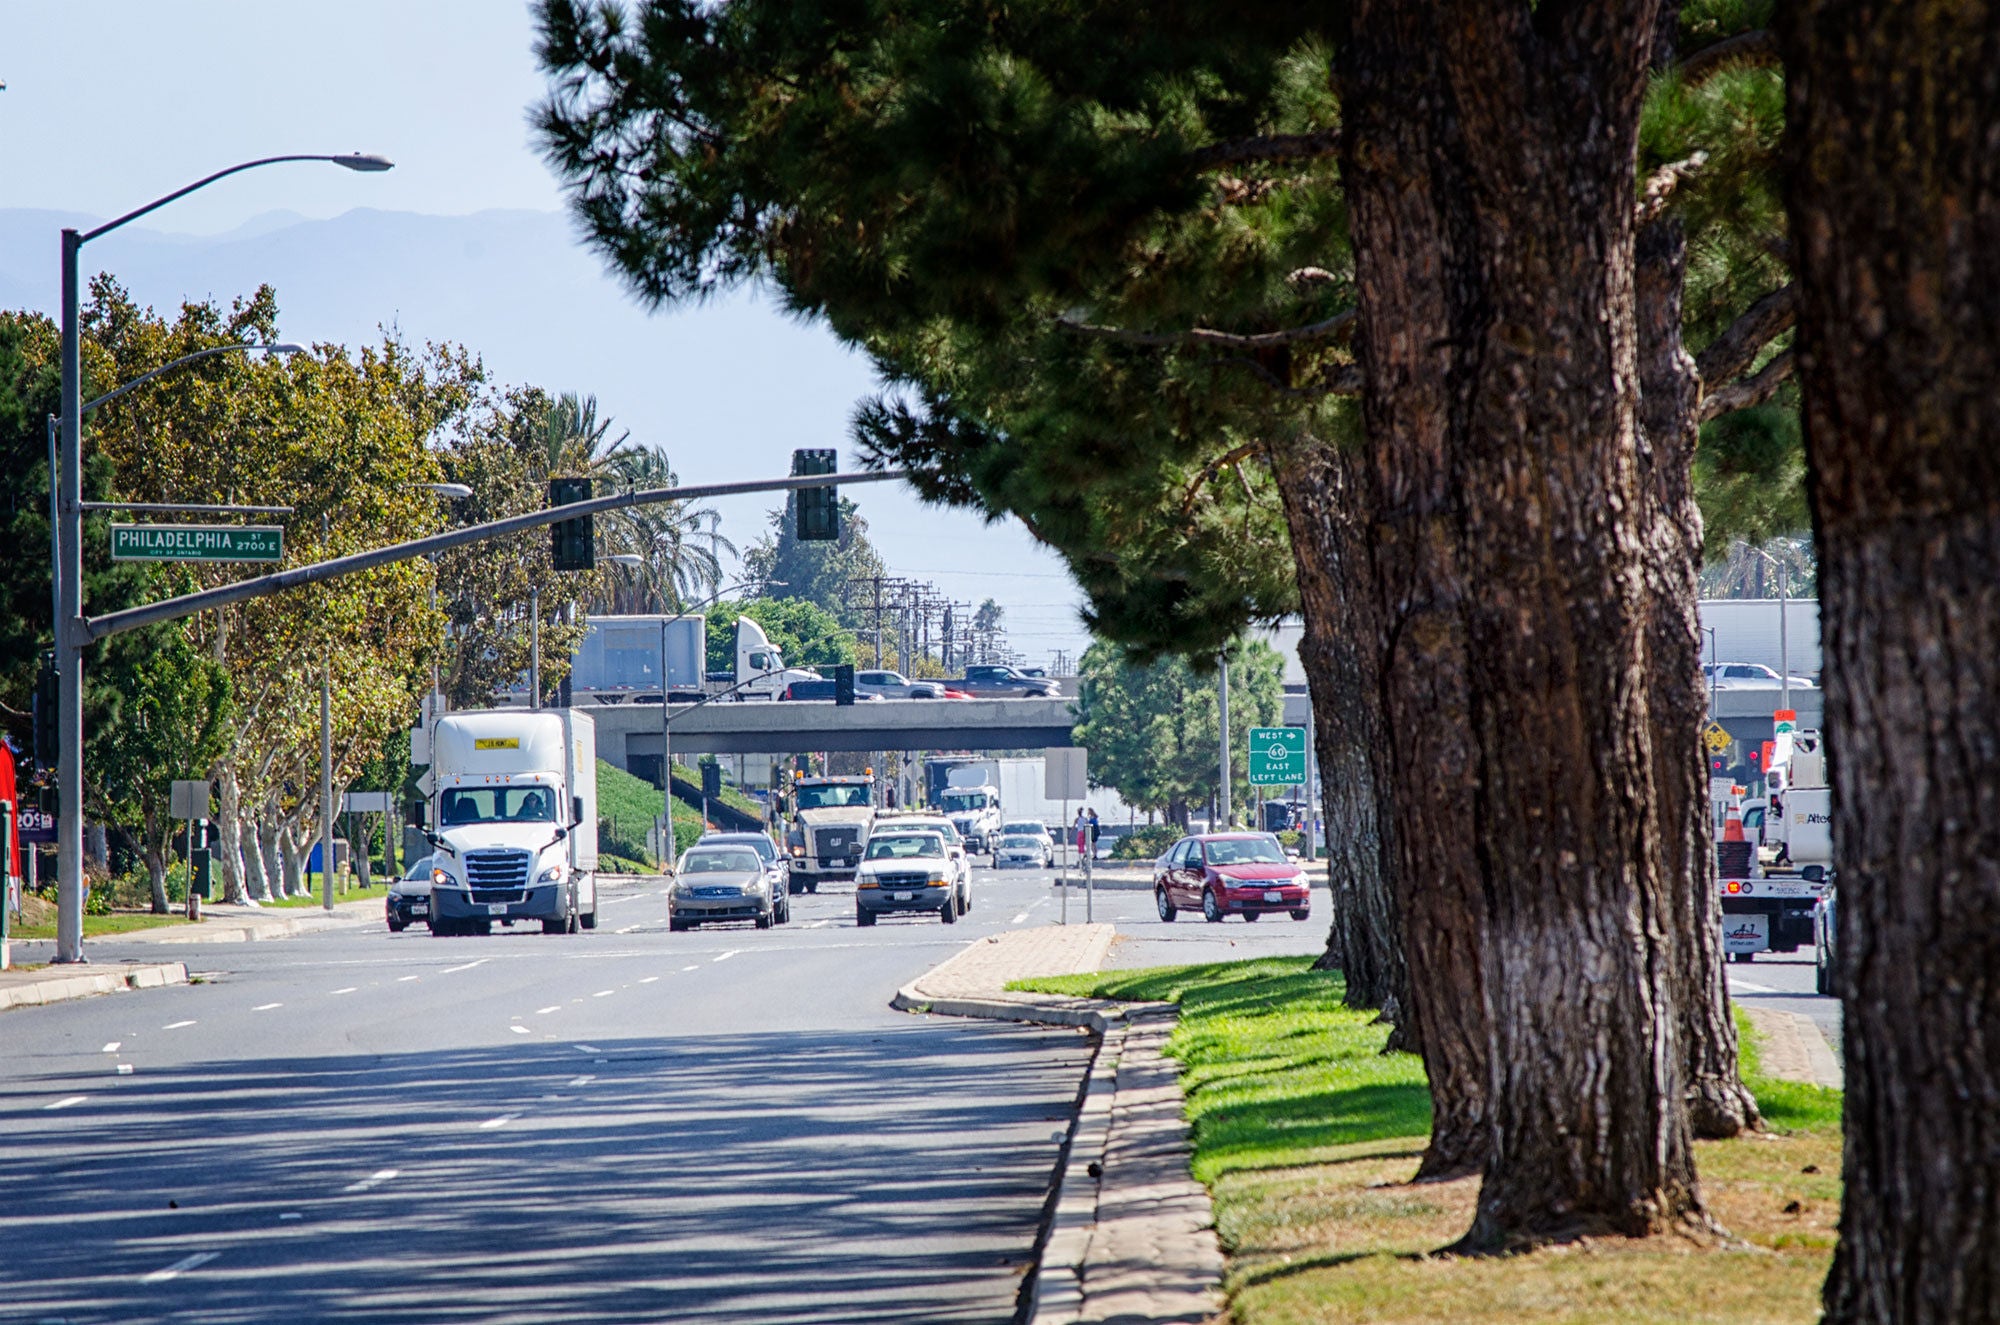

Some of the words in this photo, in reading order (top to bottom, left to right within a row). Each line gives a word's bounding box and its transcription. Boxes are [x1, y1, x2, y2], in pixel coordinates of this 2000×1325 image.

[119, 531, 232, 549] PHILADELPHIA
[237, 541, 265, 551] 2700
[269, 542, 276, 551] E
[1258, 731, 1283, 740] WEST
[1271, 748, 1284, 757] 60
[1252, 773, 1276, 781] LEFT
[1278, 772, 1303, 781] LANE
